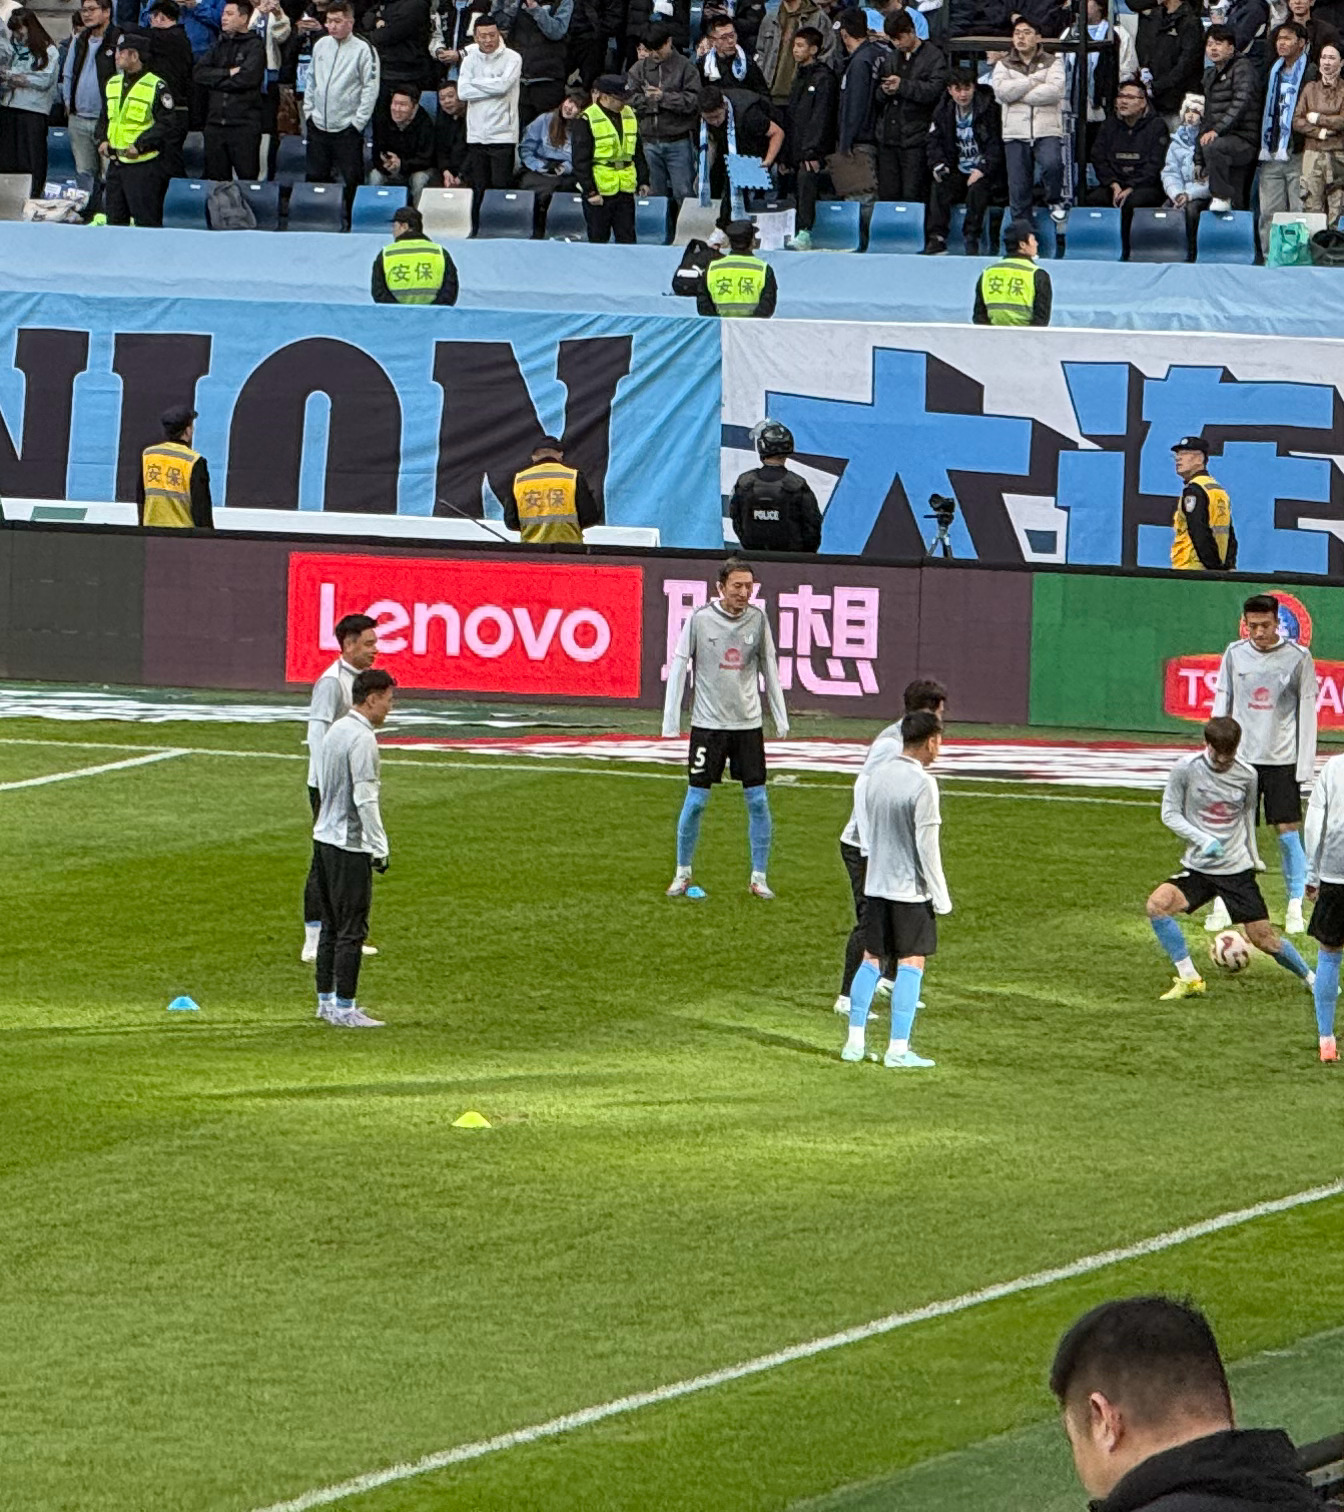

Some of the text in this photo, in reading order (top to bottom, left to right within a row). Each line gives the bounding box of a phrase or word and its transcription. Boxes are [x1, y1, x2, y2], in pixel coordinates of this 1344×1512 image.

[391, 262, 434, 283] 安保
[715, 275, 756, 296] 安保
[985, 275, 1026, 298] 安保
[146, 462, 186, 488] 安保
[523, 487, 567, 511] 安保
[318, 582, 612, 662] Lenovo
[694, 746, 707, 767] 5
